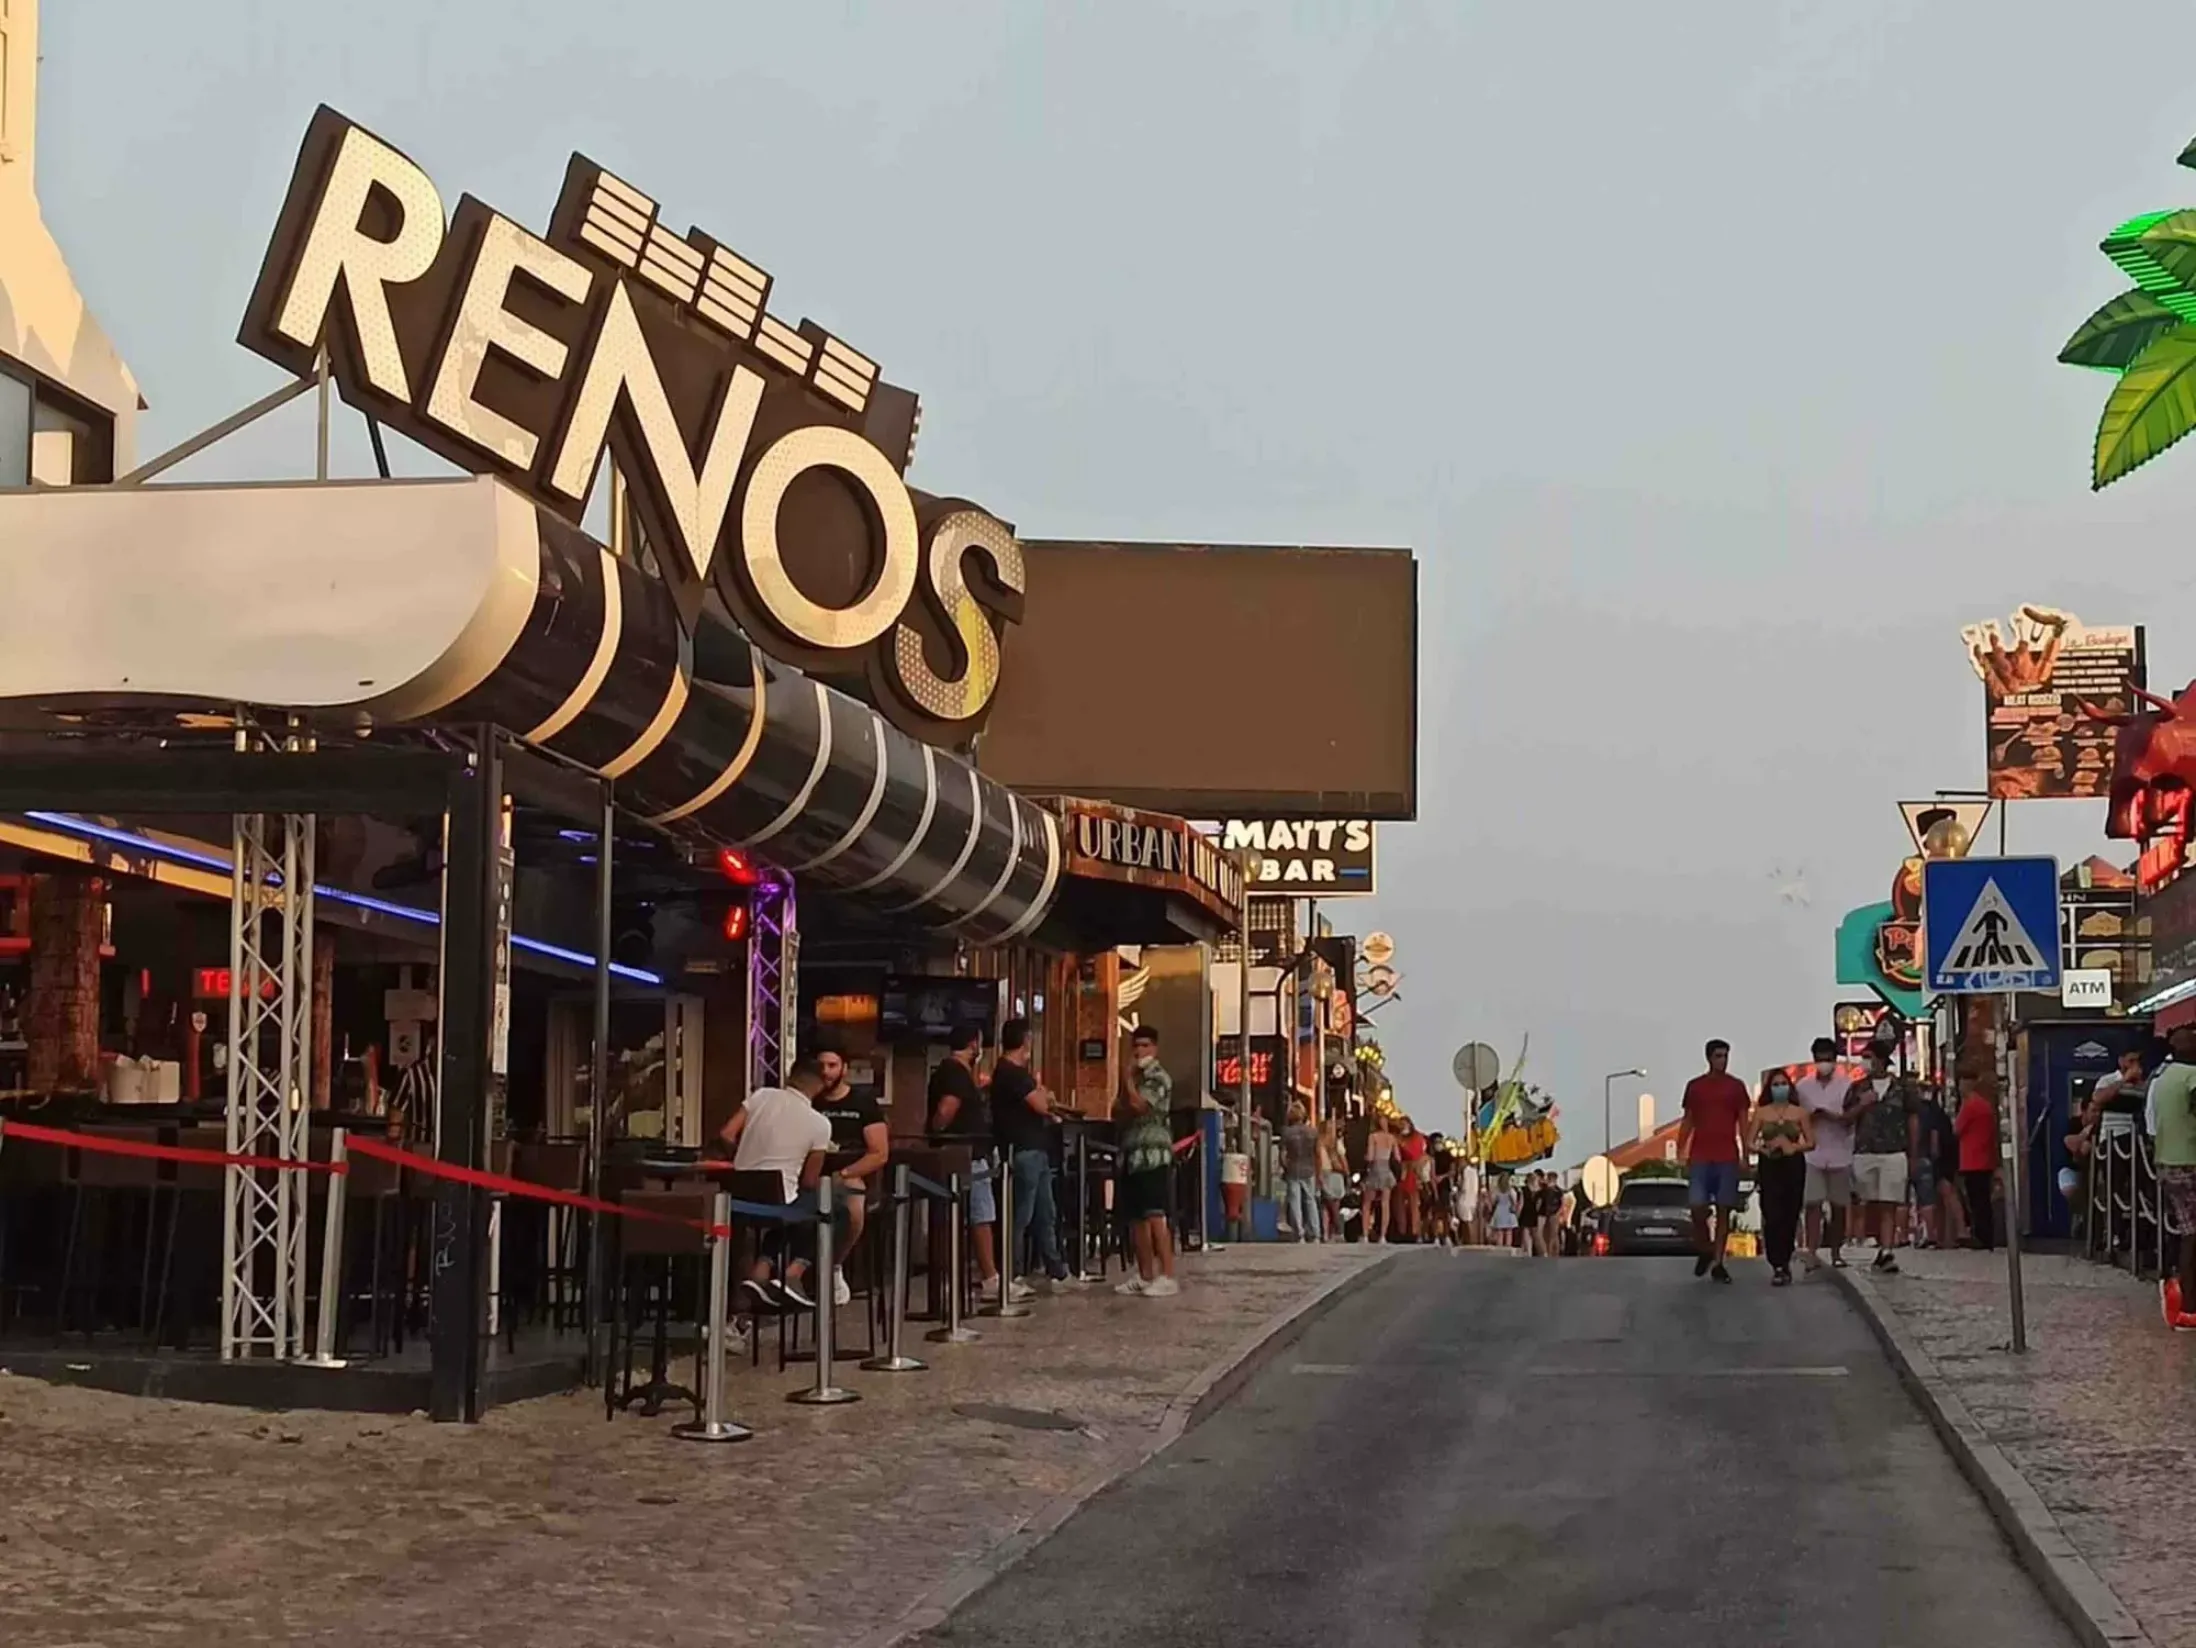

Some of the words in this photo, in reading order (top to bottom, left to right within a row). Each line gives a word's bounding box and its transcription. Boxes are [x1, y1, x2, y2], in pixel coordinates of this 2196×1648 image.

[278, 126, 1025, 721] RENOS
[1078, 814, 1184, 872] URBAN
[1223, 819, 1371, 852] MATT'S
[1258, 858, 1336, 882] BAR
[2068, 981, 2106, 995] ATM
